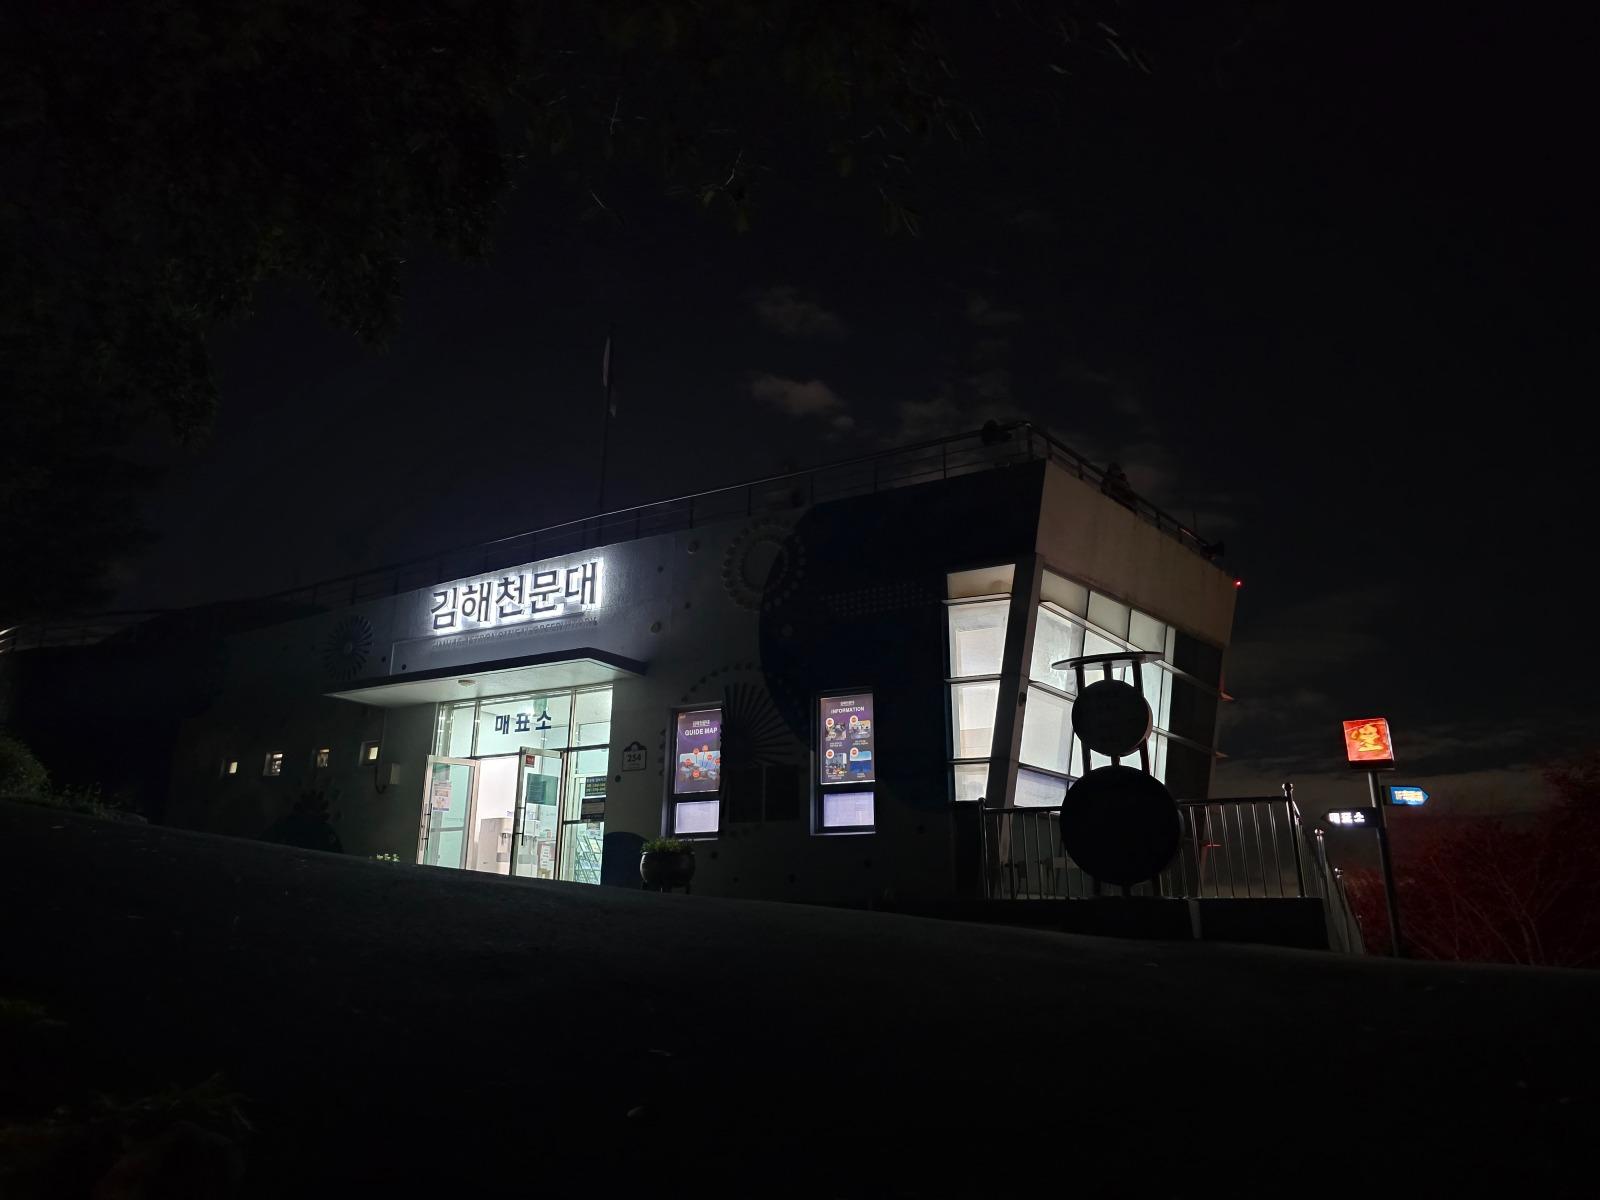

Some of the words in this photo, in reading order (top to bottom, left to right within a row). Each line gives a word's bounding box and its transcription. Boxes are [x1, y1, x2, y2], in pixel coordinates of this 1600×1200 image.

[430, 562, 598, 630] 김해천문대
[830, 706, 865, 714] INFORMATION
[495, 711, 552, 735] 매표소
[684, 728, 704, 736] GUIDE
[704, 727, 718, 735] MAP
